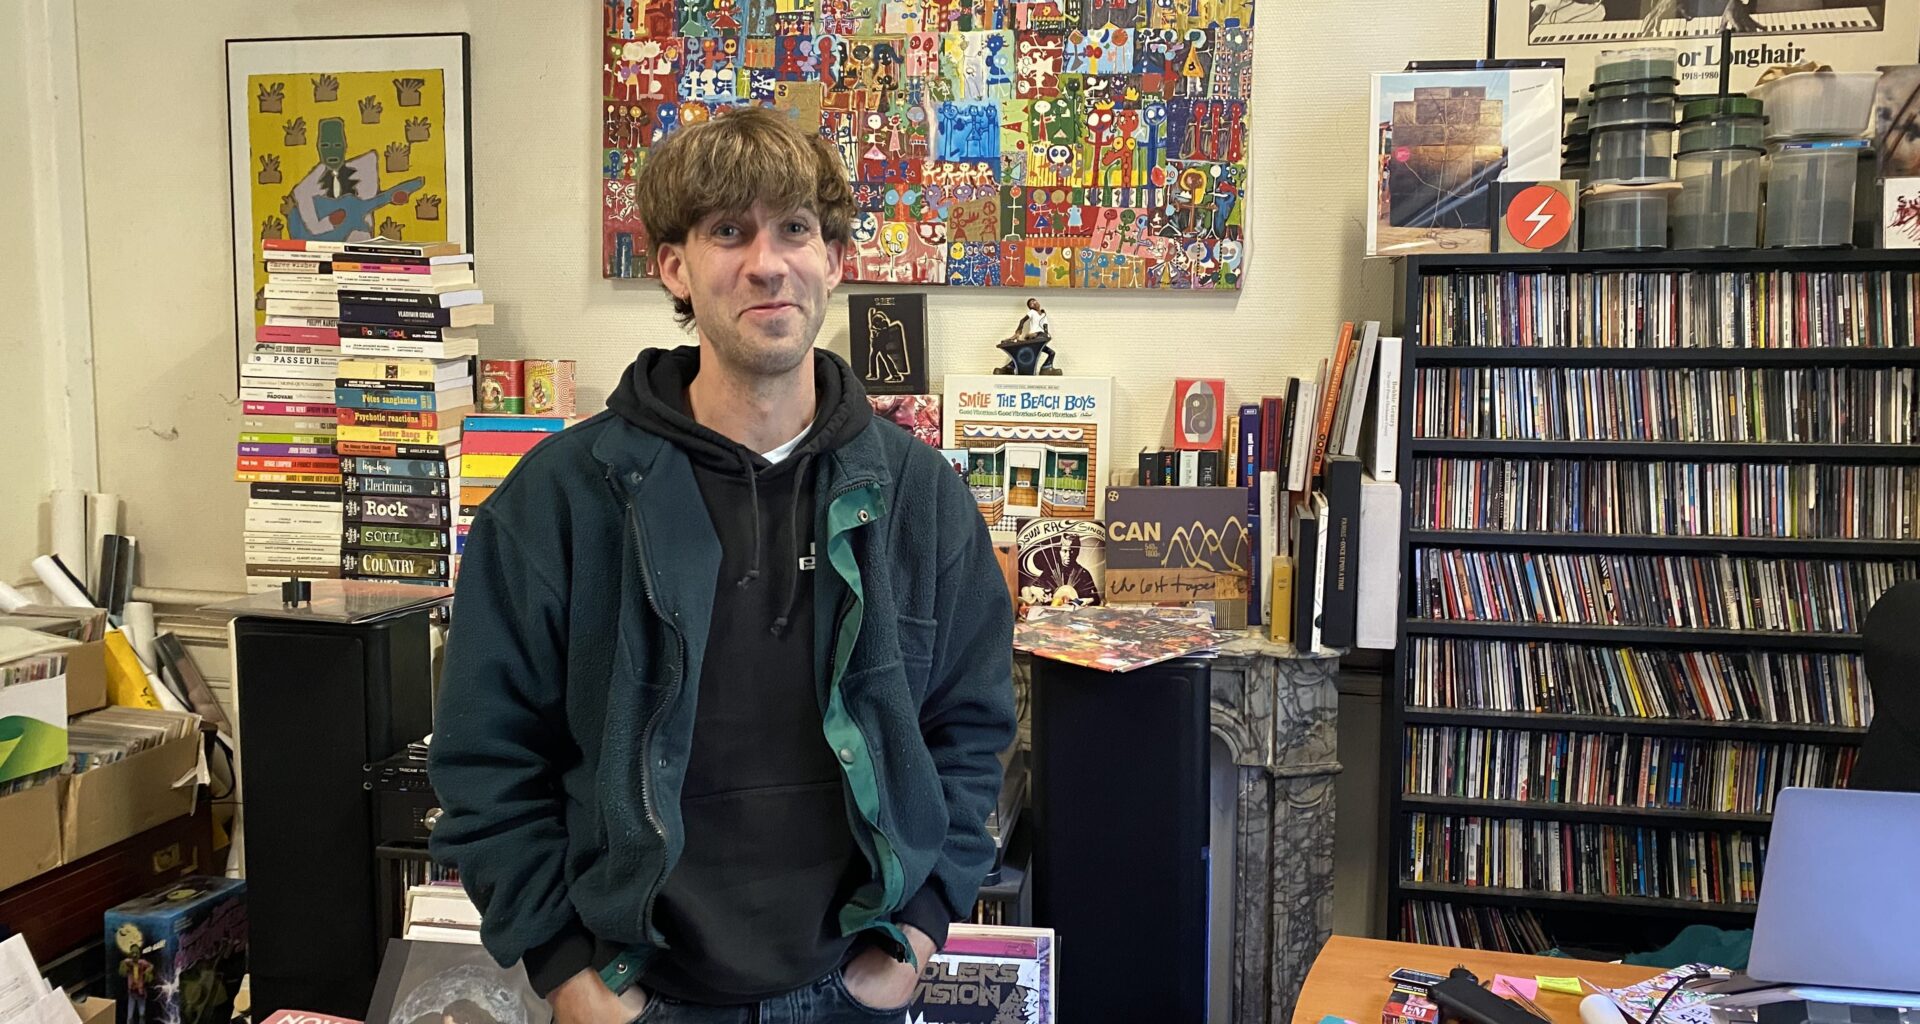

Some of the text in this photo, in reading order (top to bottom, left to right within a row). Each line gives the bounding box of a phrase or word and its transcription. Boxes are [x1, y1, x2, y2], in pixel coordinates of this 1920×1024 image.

[273, 355, 320, 365] PASSEUR
[997, 392, 1096, 411] THE BEACH BOYS
[354, 411, 386, 423] Psychotic
[388, 413, 419, 423] reactions
[379, 429, 398, 437] Lester
[364, 478, 412, 493] Electronica
[364, 500, 409, 517] Rock
[365, 530, 403, 543] SOUL
[1024, 525, 1041, 543] SUN
[1043, 521, 1060, 535] RA
[1108, 521, 1161, 541] CAN
[362, 554, 415, 574] COUNTRY
[1111, 577, 1136, 595] the
[1140, 576, 1168, 594] lost
[1402, 1004, 1427, 1018] L&M
